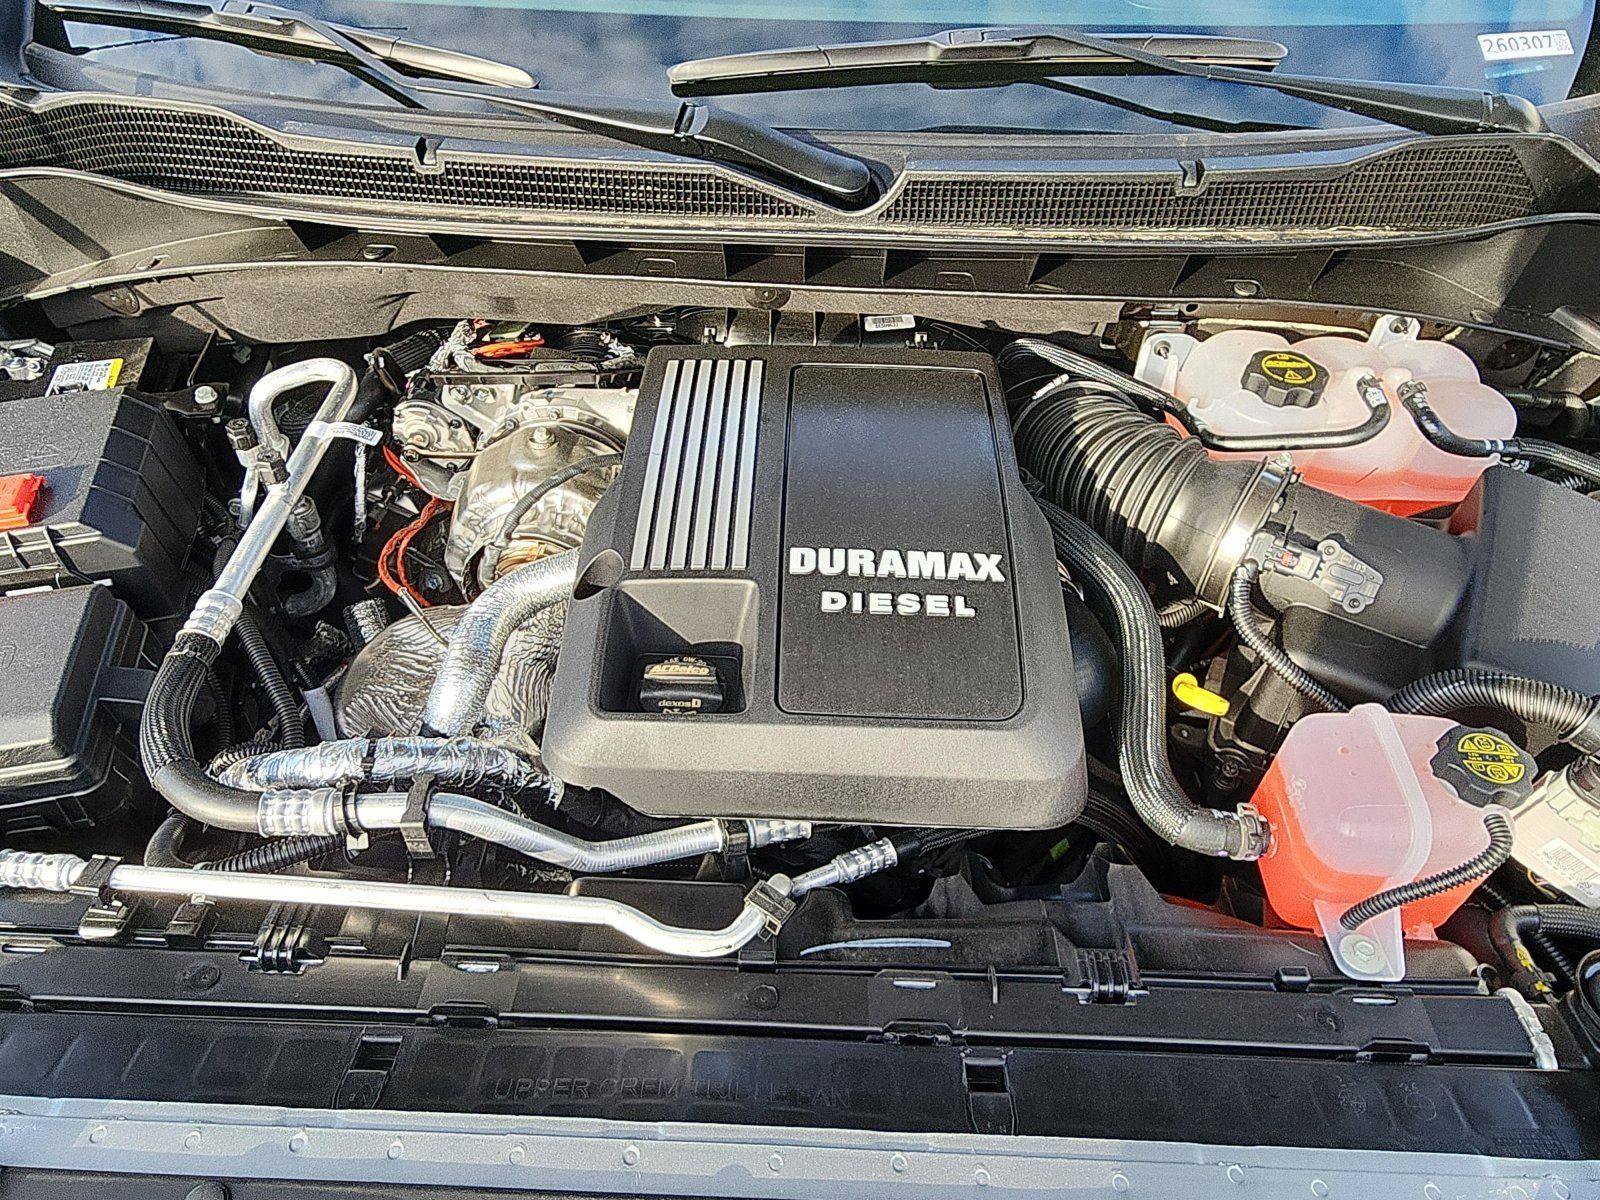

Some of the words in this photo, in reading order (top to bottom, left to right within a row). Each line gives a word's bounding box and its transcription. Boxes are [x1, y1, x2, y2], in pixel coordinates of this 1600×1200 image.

[1483, 35, 1552, 54] 260307
[789, 547, 1006, 582] DURAMAX
[821, 591, 976, 617] DIESEL
[647, 664, 711, 675] ACDelco
[494, 1077, 590, 1100] UPPER
